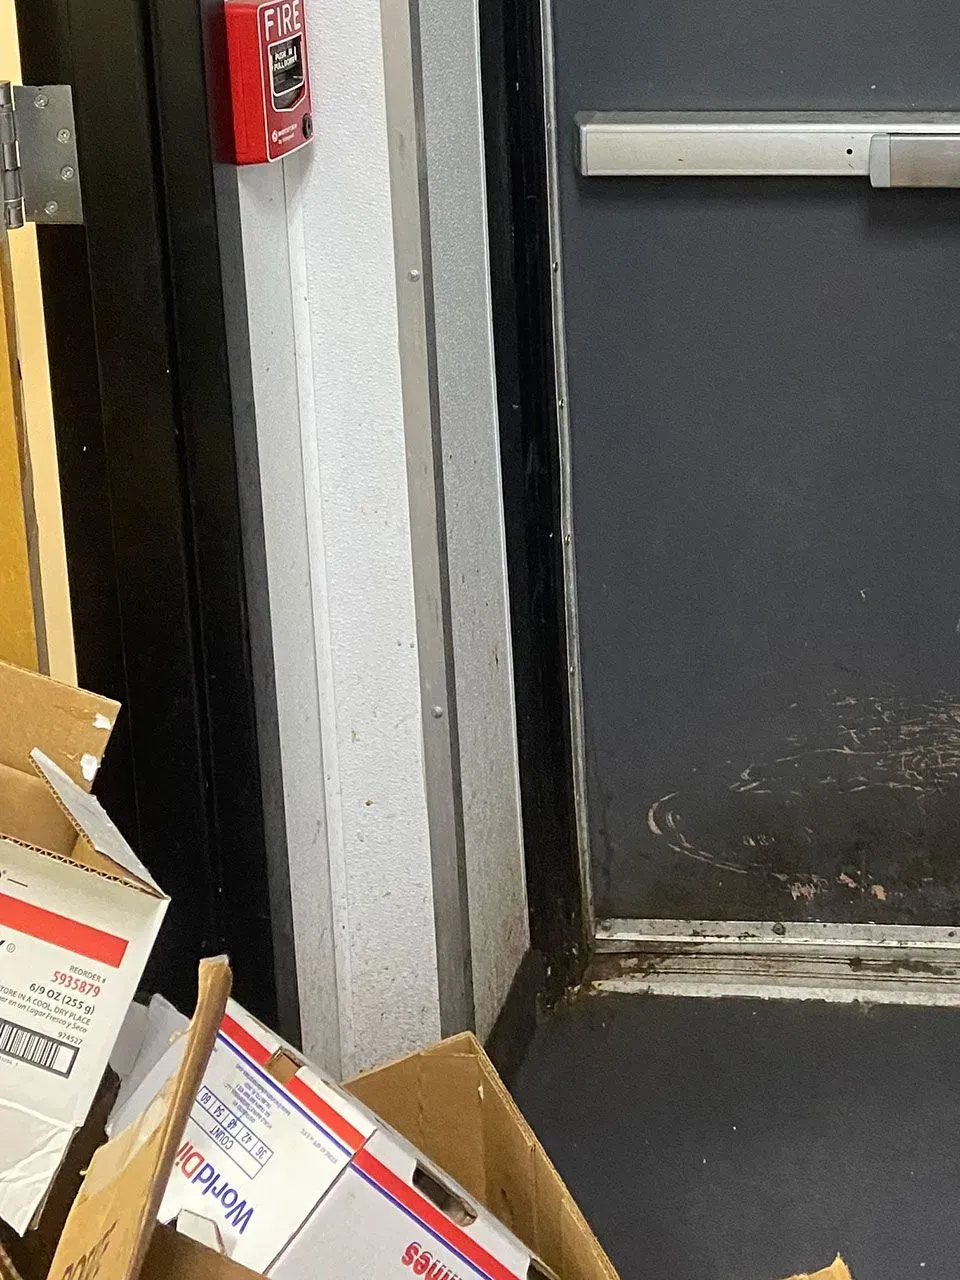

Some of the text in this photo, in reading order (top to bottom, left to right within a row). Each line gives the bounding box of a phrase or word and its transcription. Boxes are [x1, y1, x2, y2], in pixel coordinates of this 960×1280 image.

[51, 970, 101, 998] 5935879
[69, 965, 101, 982] REORDER
[17, 992, 27, 1001] IN
[32, 998, 53, 1012] COOL,
[53, 1006, 69, 1017] DRY
[69, 1012, 92, 1026] PLACE
[29, 983, 95, 1015] 6/9 OZ (255 g)
[58, 1031, 84, 1045] 974527
[71, 1022, 88, 1033] Seco
[201, 1092, 268, 1159] 36 42 48 54 60
[209, 1124, 234, 1150] COUNT
